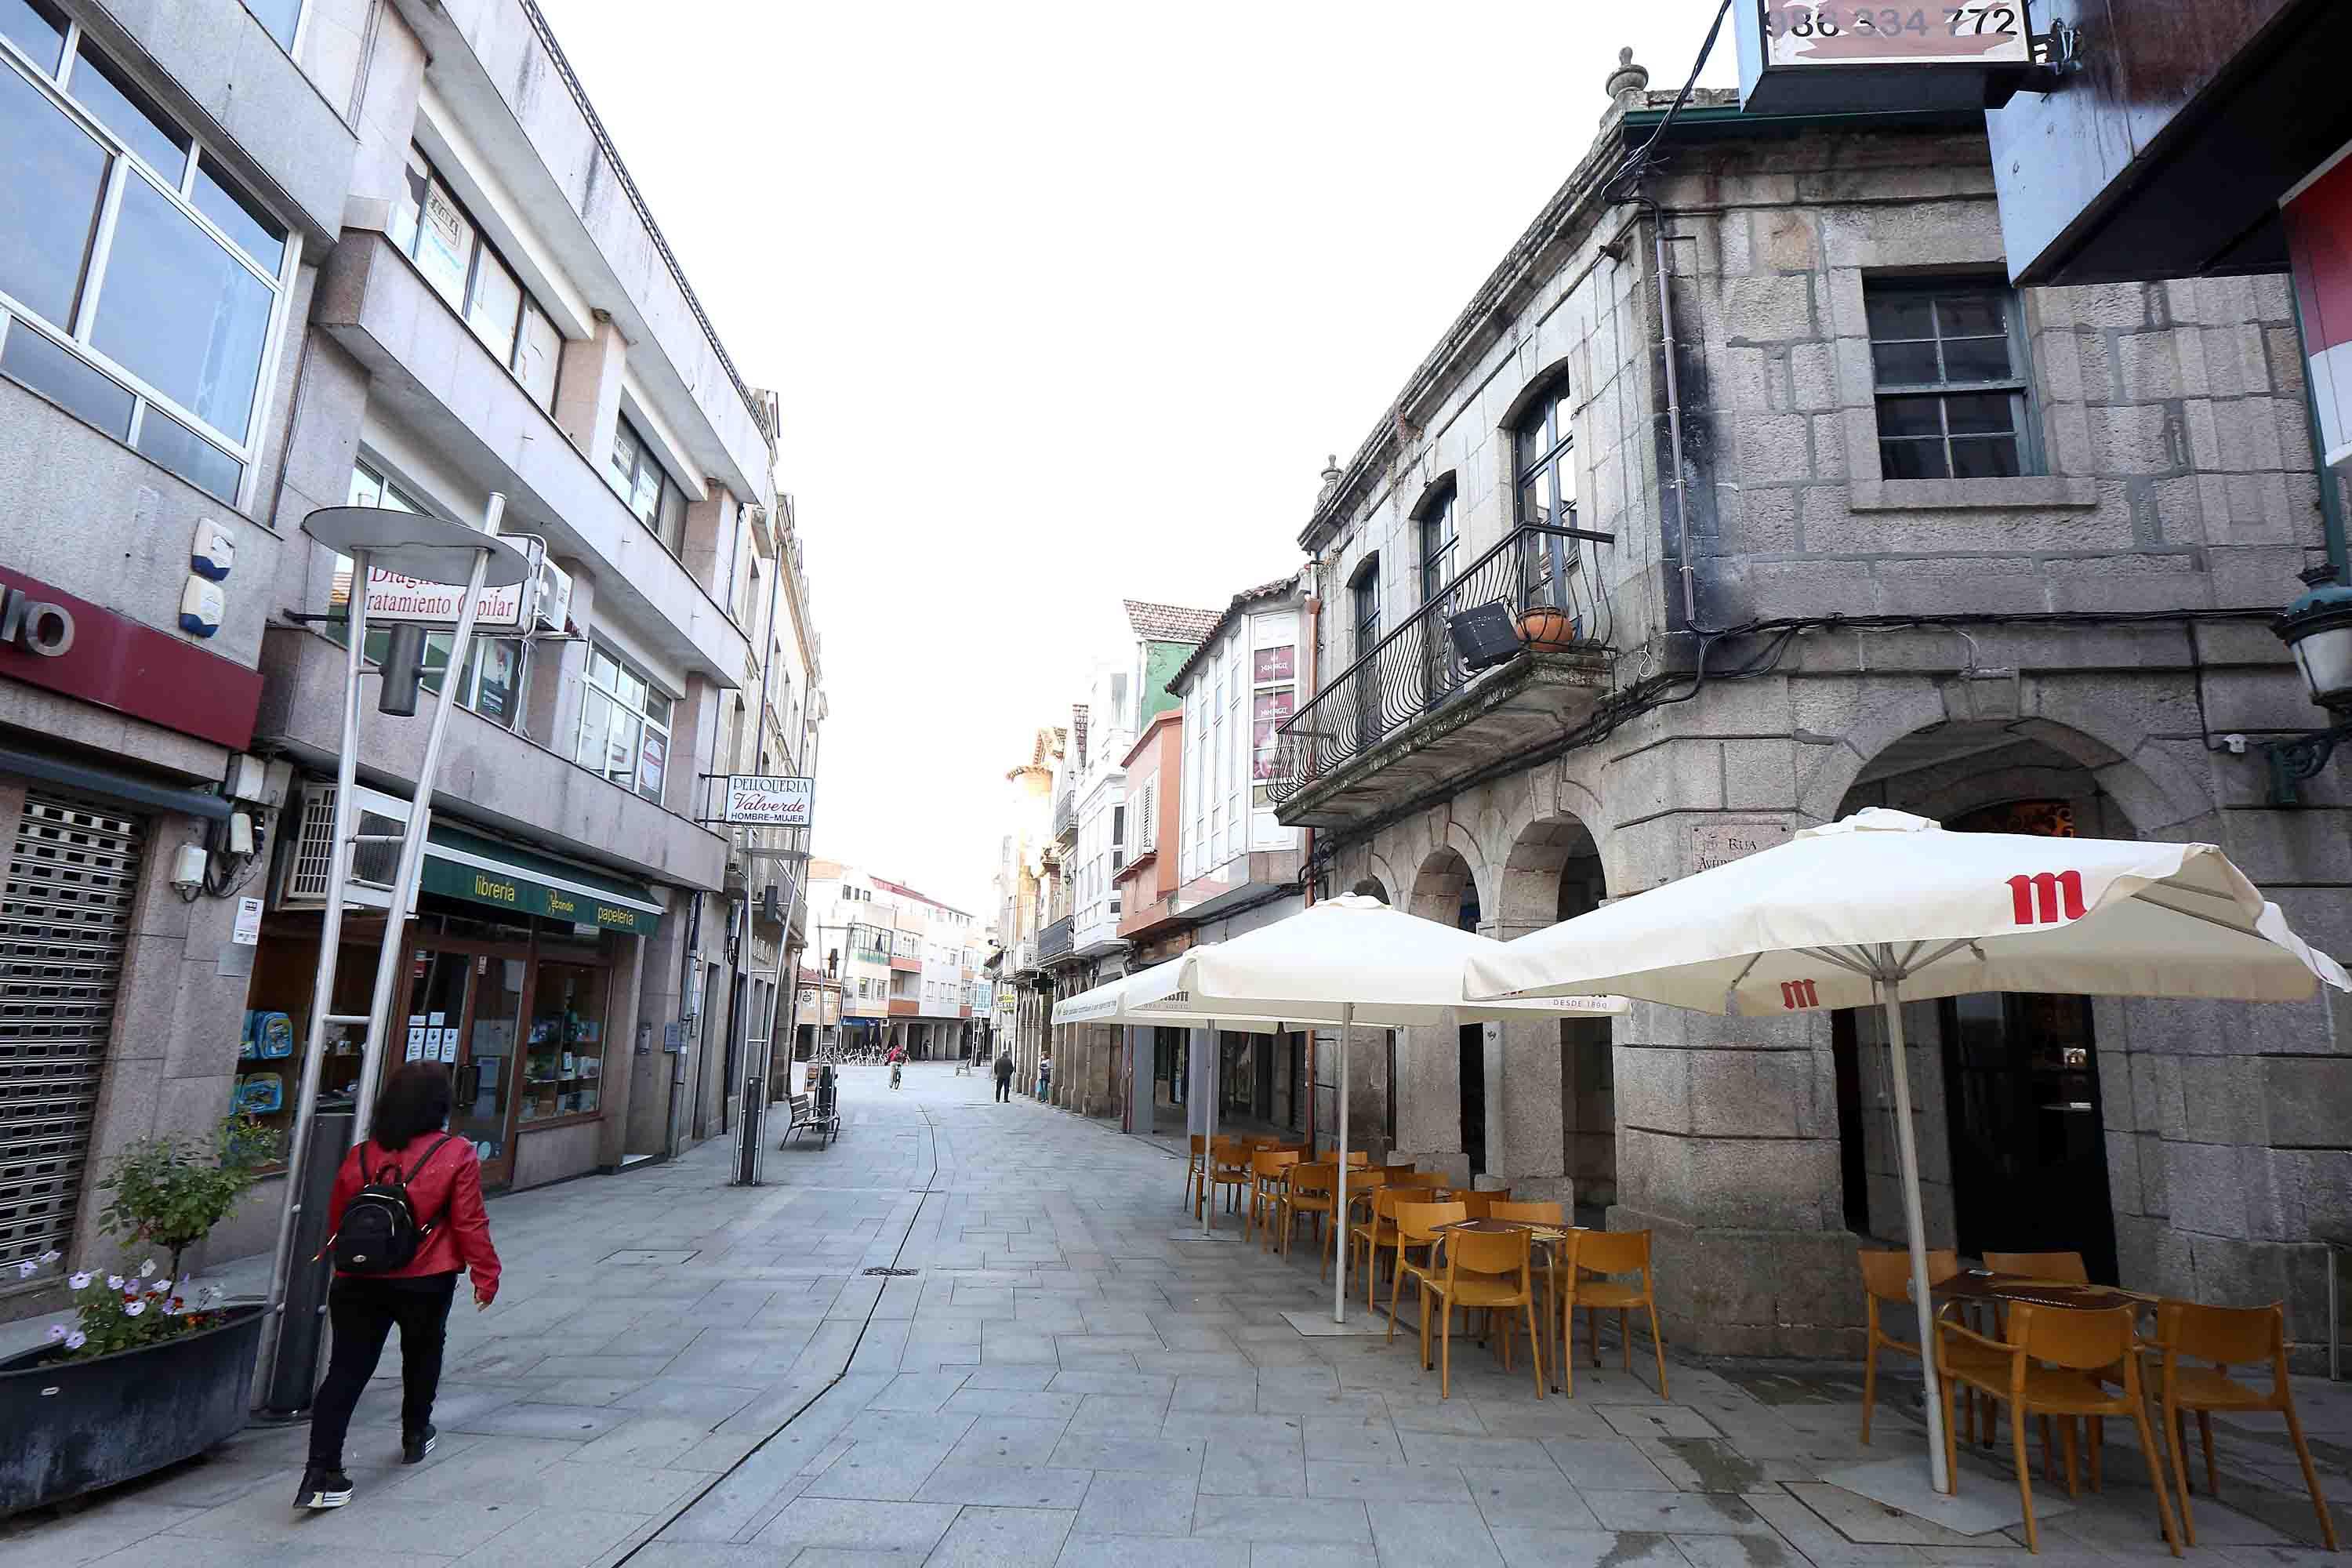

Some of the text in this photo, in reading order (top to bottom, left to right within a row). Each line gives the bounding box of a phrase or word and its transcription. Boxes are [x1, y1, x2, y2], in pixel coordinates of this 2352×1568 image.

[367, 592, 514, 620] ratamiento Cpilar
[733, 778, 808, 793] PELUQUERIA
[733, 793, 806, 813] Valverde
[731, 812, 805, 822] HOMBRE-MUJER
[476, 875, 515, 902] librería
[597, 906, 633, 926] papelería
[1553, 999, 1582, 1008] DESDE
